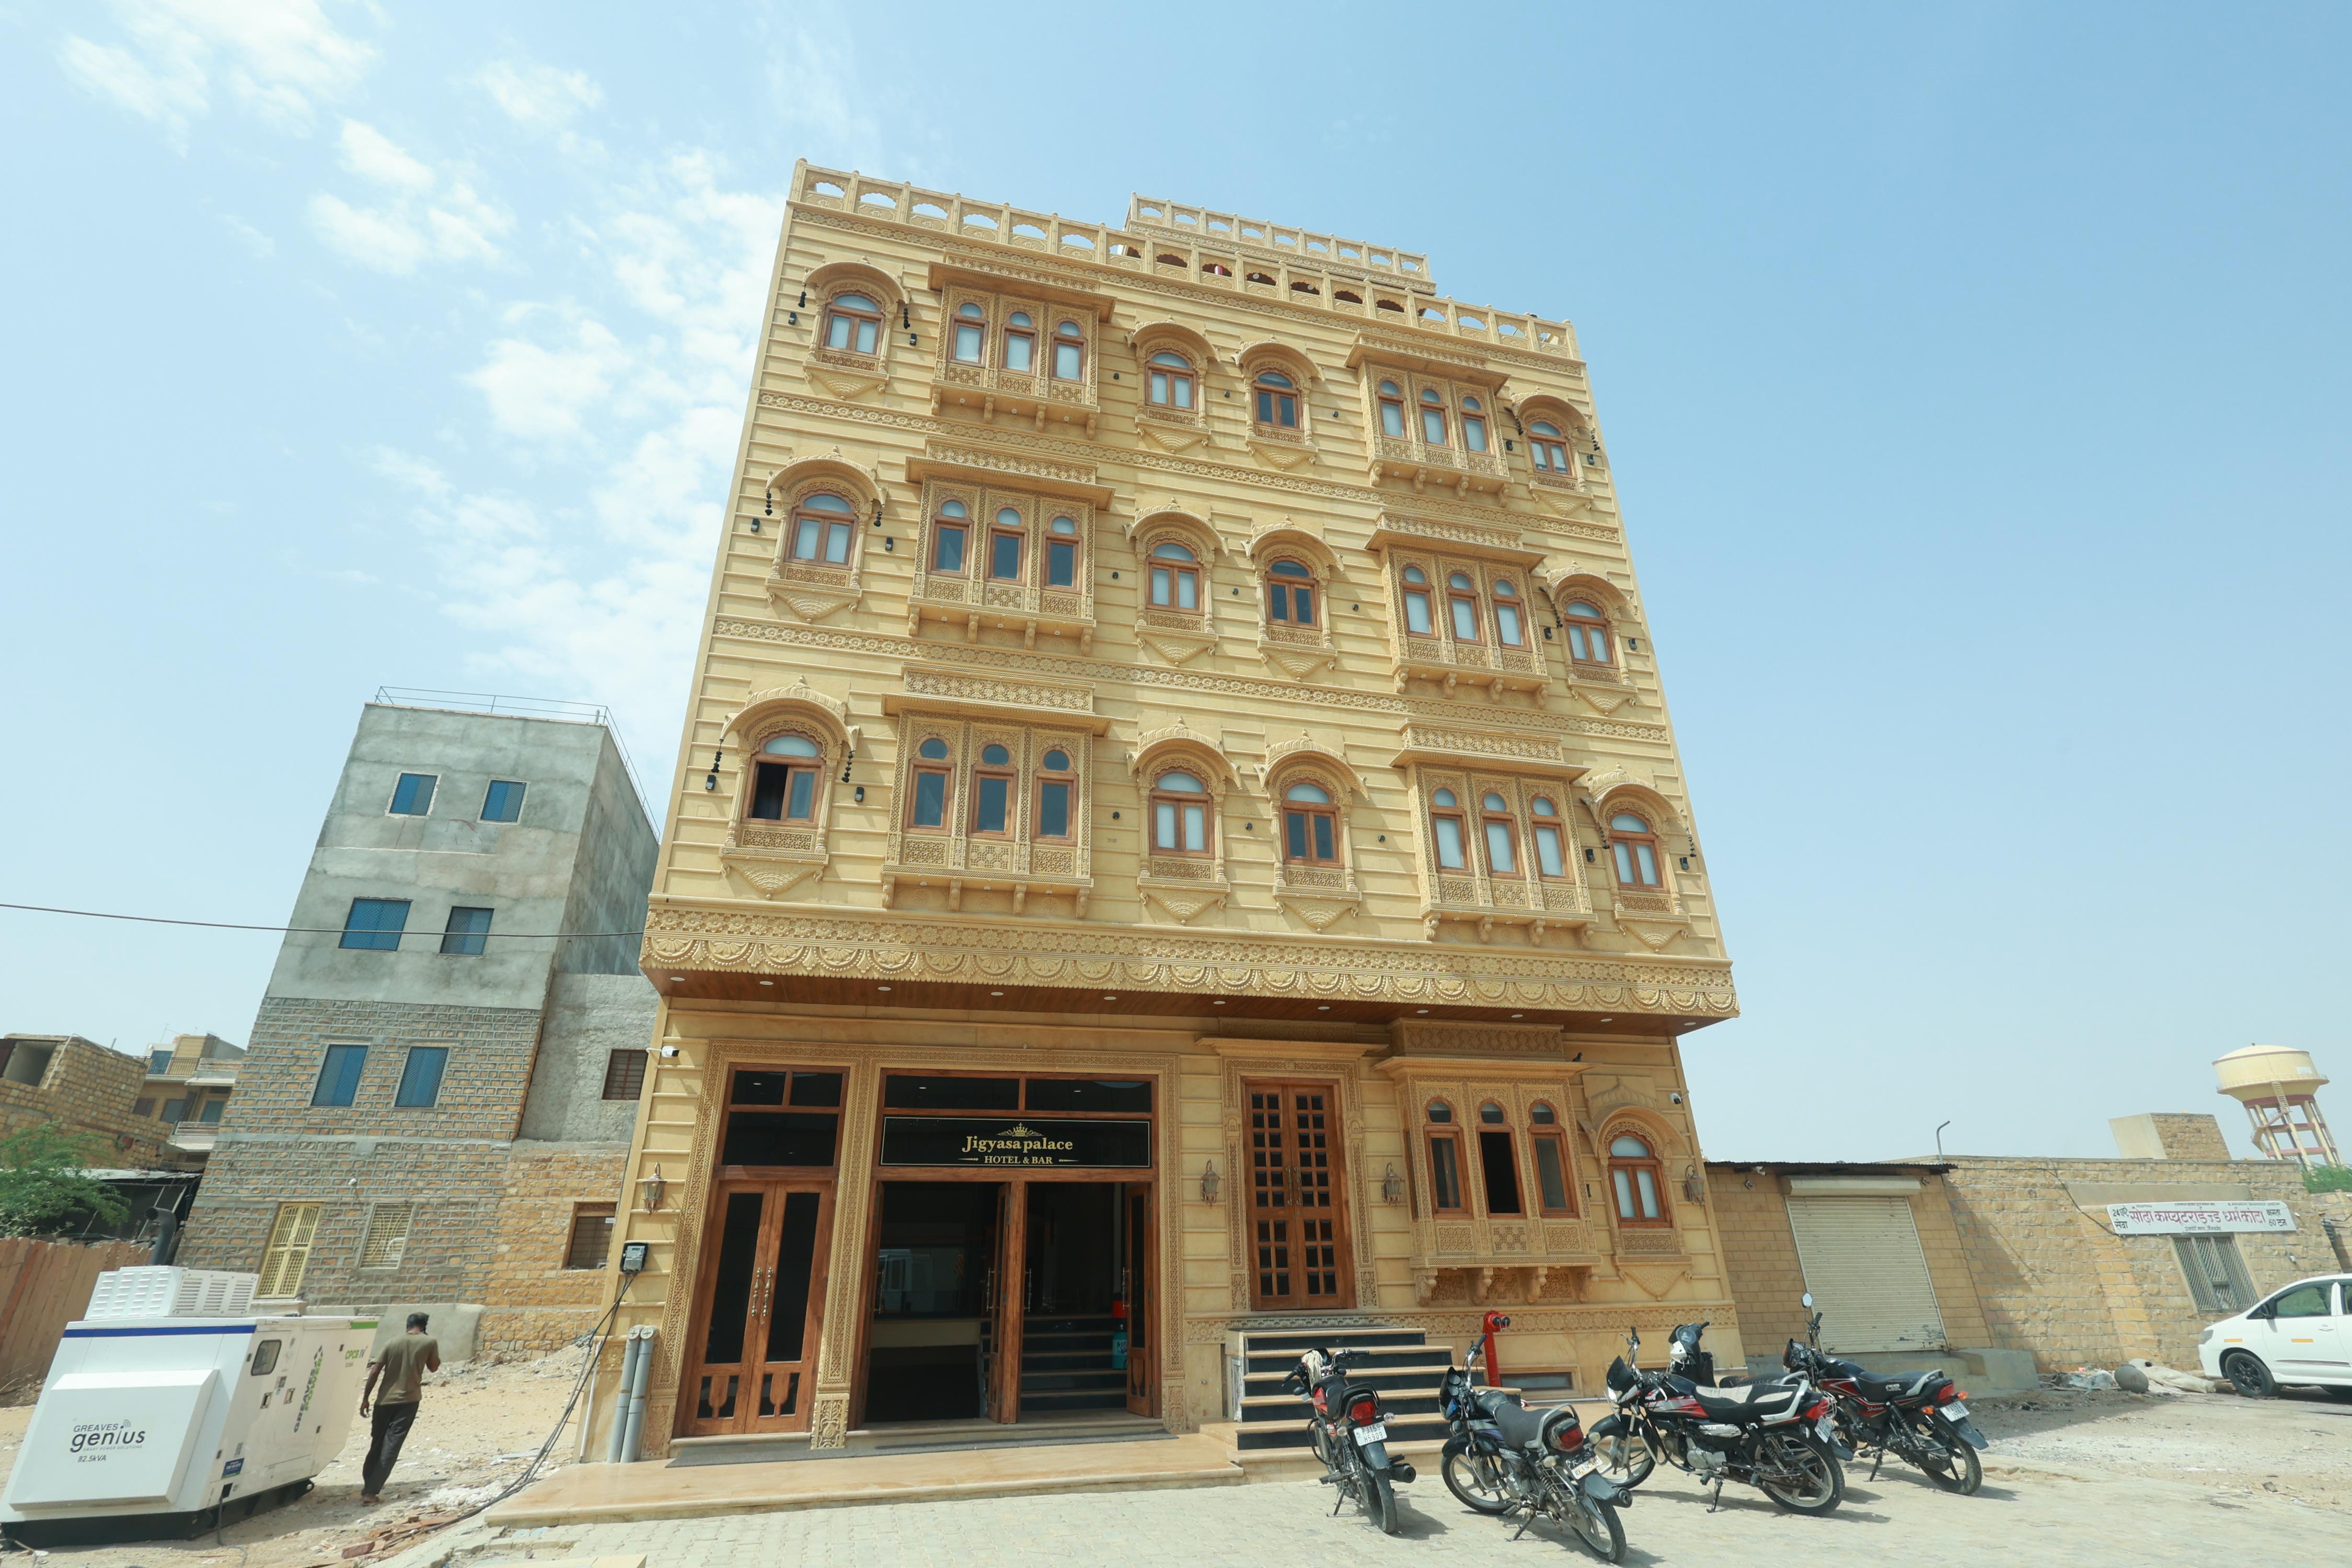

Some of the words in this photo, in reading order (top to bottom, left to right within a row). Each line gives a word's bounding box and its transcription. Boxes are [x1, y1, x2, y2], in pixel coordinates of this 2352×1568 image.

[962, 1136, 1022, 1153] Jigyasa
[1023, 1137, 1073, 1154] palace
[984, 1156, 1021, 1164] HOTEL
[2114, 1218, 2128, 1229] सेवा
[304, 1357, 322, 1411] POWER
[294, 1369, 315, 1433] GREAVES
[73, 1423, 119, 1433] GREAVES
[70, 1426, 145, 1453] genius
[1364, 1431, 1383, 1443] H5909
